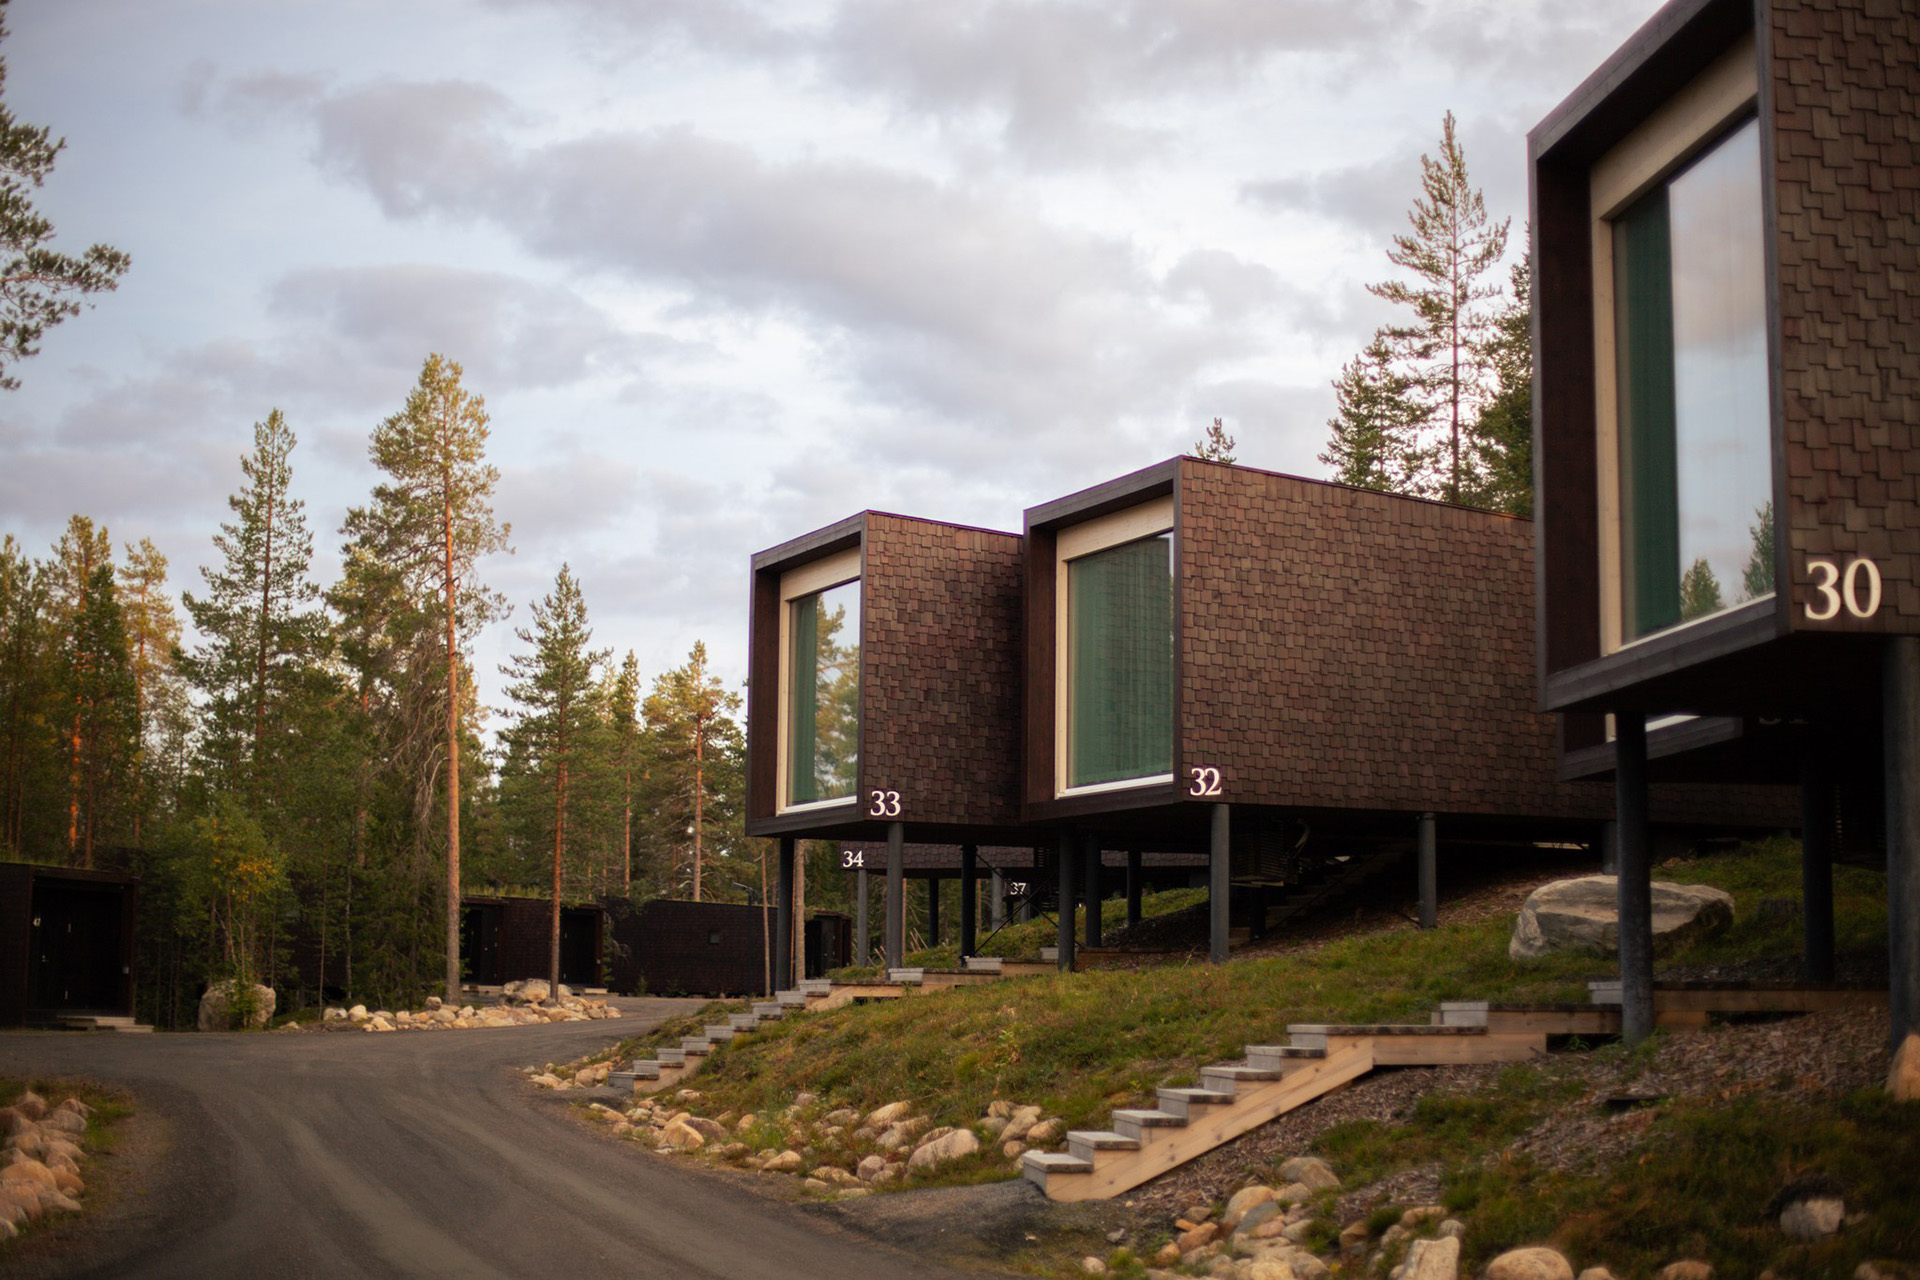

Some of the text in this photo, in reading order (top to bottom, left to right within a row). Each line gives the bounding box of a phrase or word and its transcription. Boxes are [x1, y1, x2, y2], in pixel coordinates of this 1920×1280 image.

[1804, 558, 1882, 620] 30
[1190, 767, 1222, 796] 32
[870, 790, 902, 817] 33
[842, 850, 865, 868] 34
[1010, 881, 1027, 895] 37
